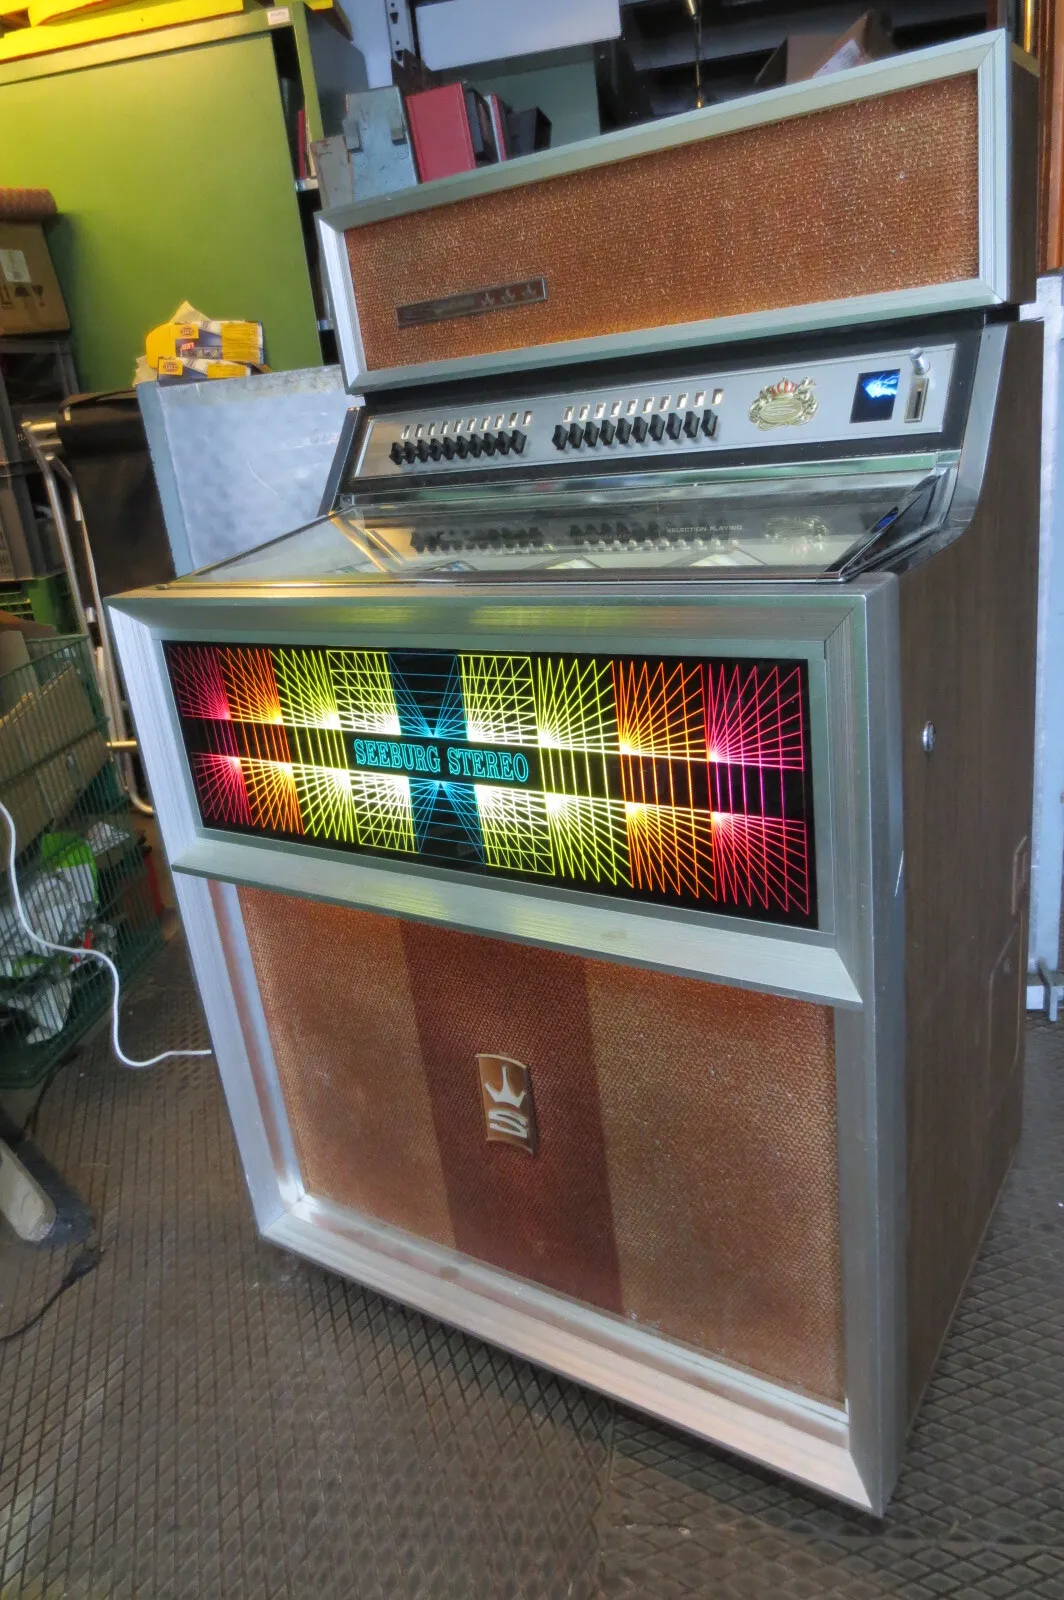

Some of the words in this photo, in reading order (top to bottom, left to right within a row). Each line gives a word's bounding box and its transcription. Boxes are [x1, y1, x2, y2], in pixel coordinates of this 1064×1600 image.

[709, 524, 743, 532] PLAYING
[353, 738, 441, 773] SEEBURG
[447, 746, 529, 782] STEREO
